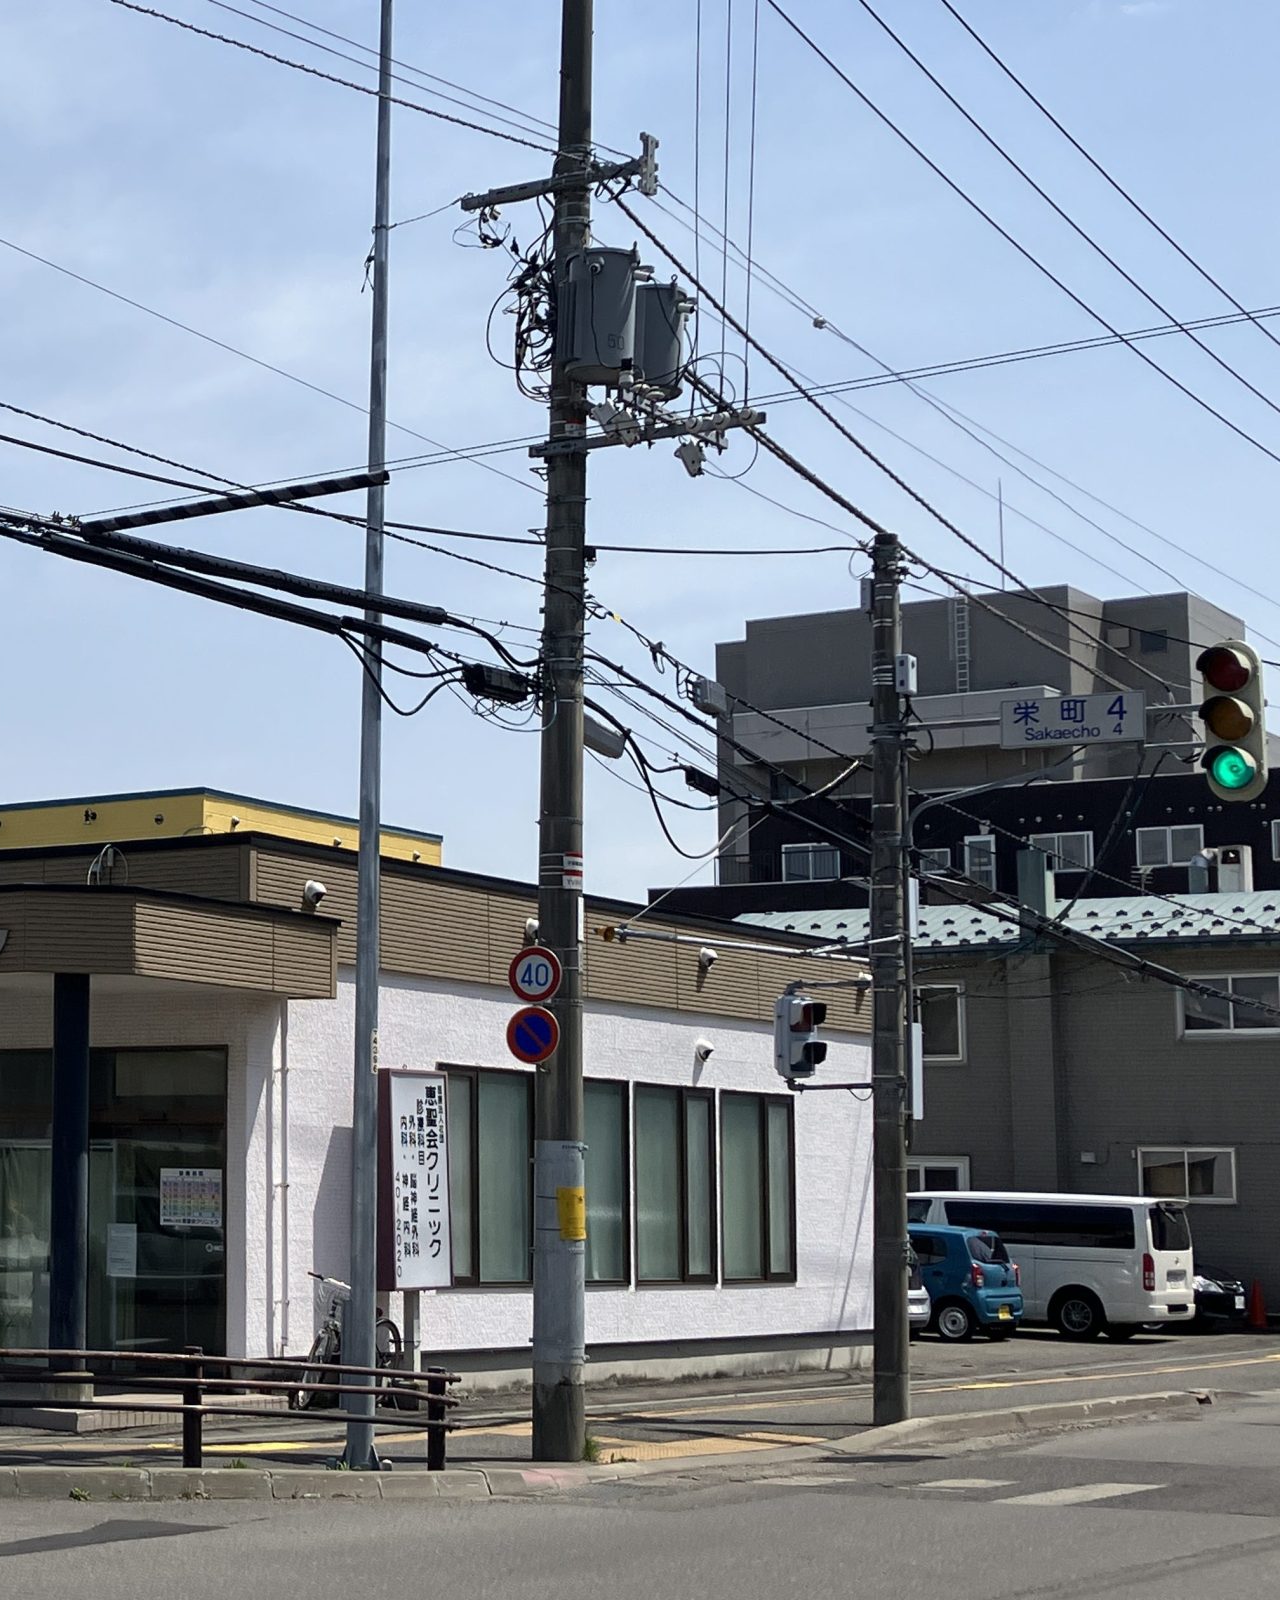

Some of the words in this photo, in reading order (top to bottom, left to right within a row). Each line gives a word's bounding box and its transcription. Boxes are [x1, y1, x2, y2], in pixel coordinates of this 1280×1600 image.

[1013, 700, 1086, 725] 栄町
[1107, 695, 1127, 720] 4
[1024, 724, 1101, 741] Sakaecho
[1113, 722, 1123, 735] 4
[520, 963, 549, 987] 40
[425, 1086, 441, 1258] 恵聖会クリニック
